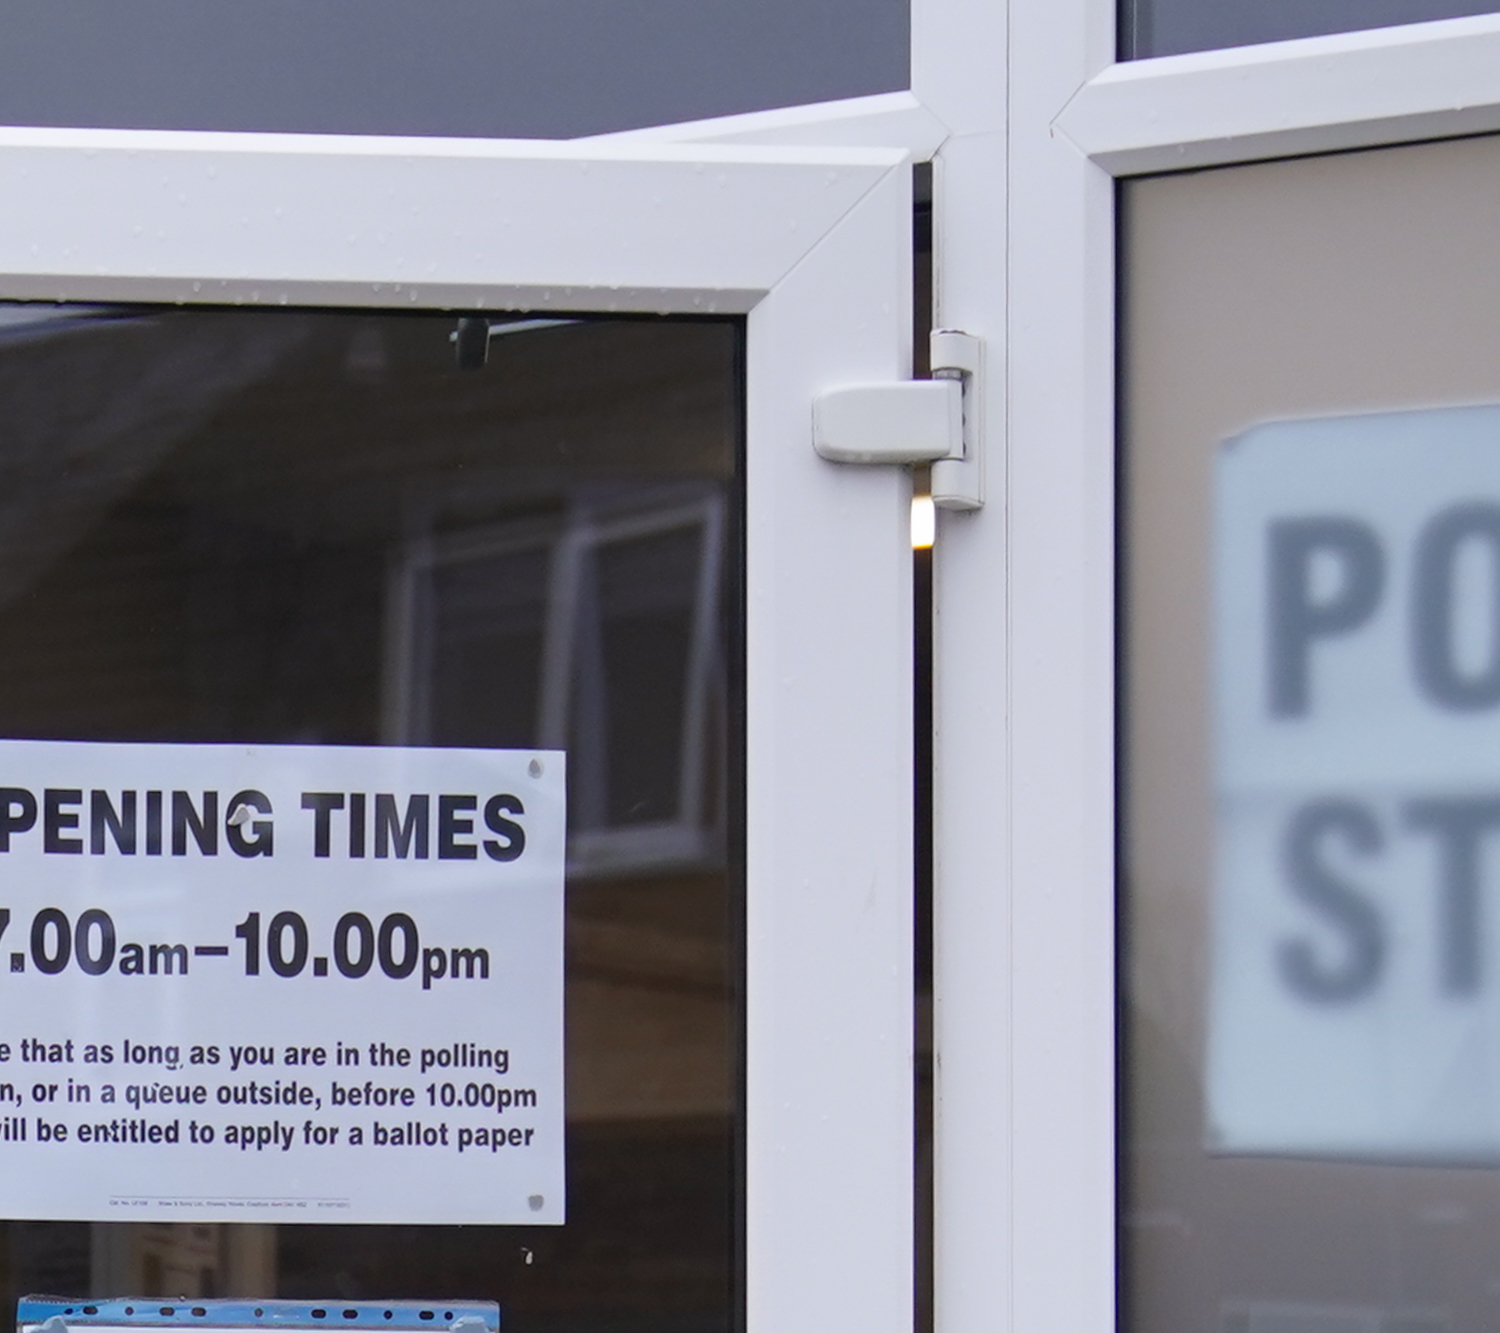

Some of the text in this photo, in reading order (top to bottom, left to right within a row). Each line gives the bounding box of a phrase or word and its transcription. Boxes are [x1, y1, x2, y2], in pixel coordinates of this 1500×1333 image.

[302, 793, 525, 862] TIMES
[21, 1038, 73, 1063] that
[84, 1045, 113, 1063] as
[123, 1040, 180, 1070] long
[190, 1046, 220, 1065] as
[230, 1047, 274, 1071] you
[284, 1047, 326, 1066] are
[337, 1042, 359, 1065] in
[369, 1043, 410, 1066] the
[421, 1043, 508, 1073] polling
[32, 1083, 58, 1102] or
[68, 1078, 90, 1102] in
[101, 1085, 115, 1103] a
[126, 1084, 207, 1110] queue
[217, 1080, 321, 1110] outside,
[332, 1081, 415, 1107] before
[427, 1083, 537, 1113] 10.00pm
[37, 1117, 67, 1142] be
[78, 1118, 179, 1143] entitled
[189, 1120, 214, 1143] to
[225, 1121, 294, 1151] apply
[303, 1121, 339, 1145] for
[349, 1127, 362, 1145] a
[374, 1121, 448, 1146] ballot
[459, 1127, 534, 1152] paper
